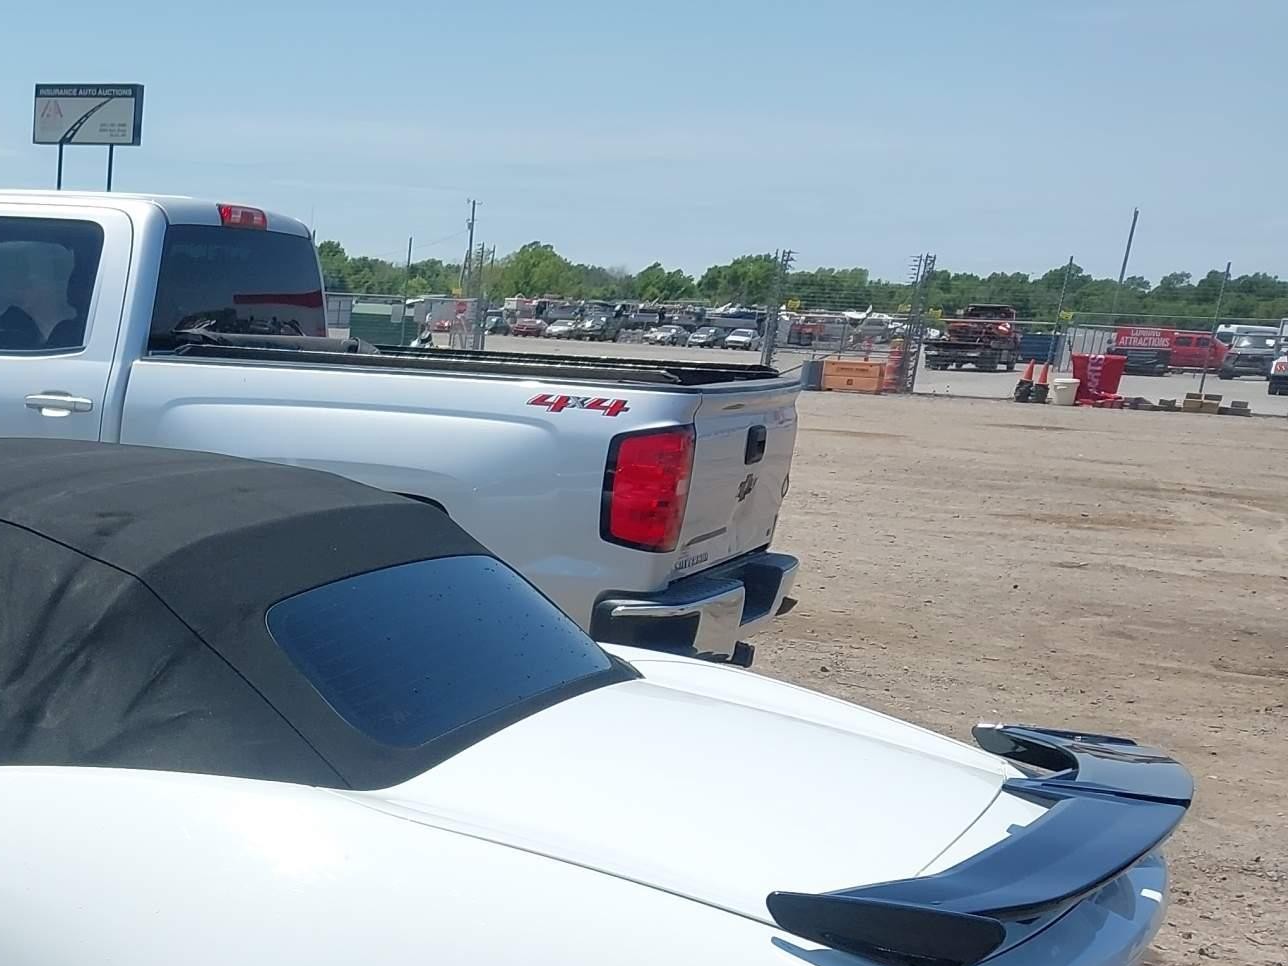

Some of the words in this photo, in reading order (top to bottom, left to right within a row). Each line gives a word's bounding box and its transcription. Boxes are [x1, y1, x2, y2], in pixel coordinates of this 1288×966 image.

[39, 88, 77, 96] INSURANCE
[78, 88, 96, 96] AUTO
[97, 88, 132, 96] AUCTIONS
[1118, 336, 1170, 347] ATTRACTIONS
